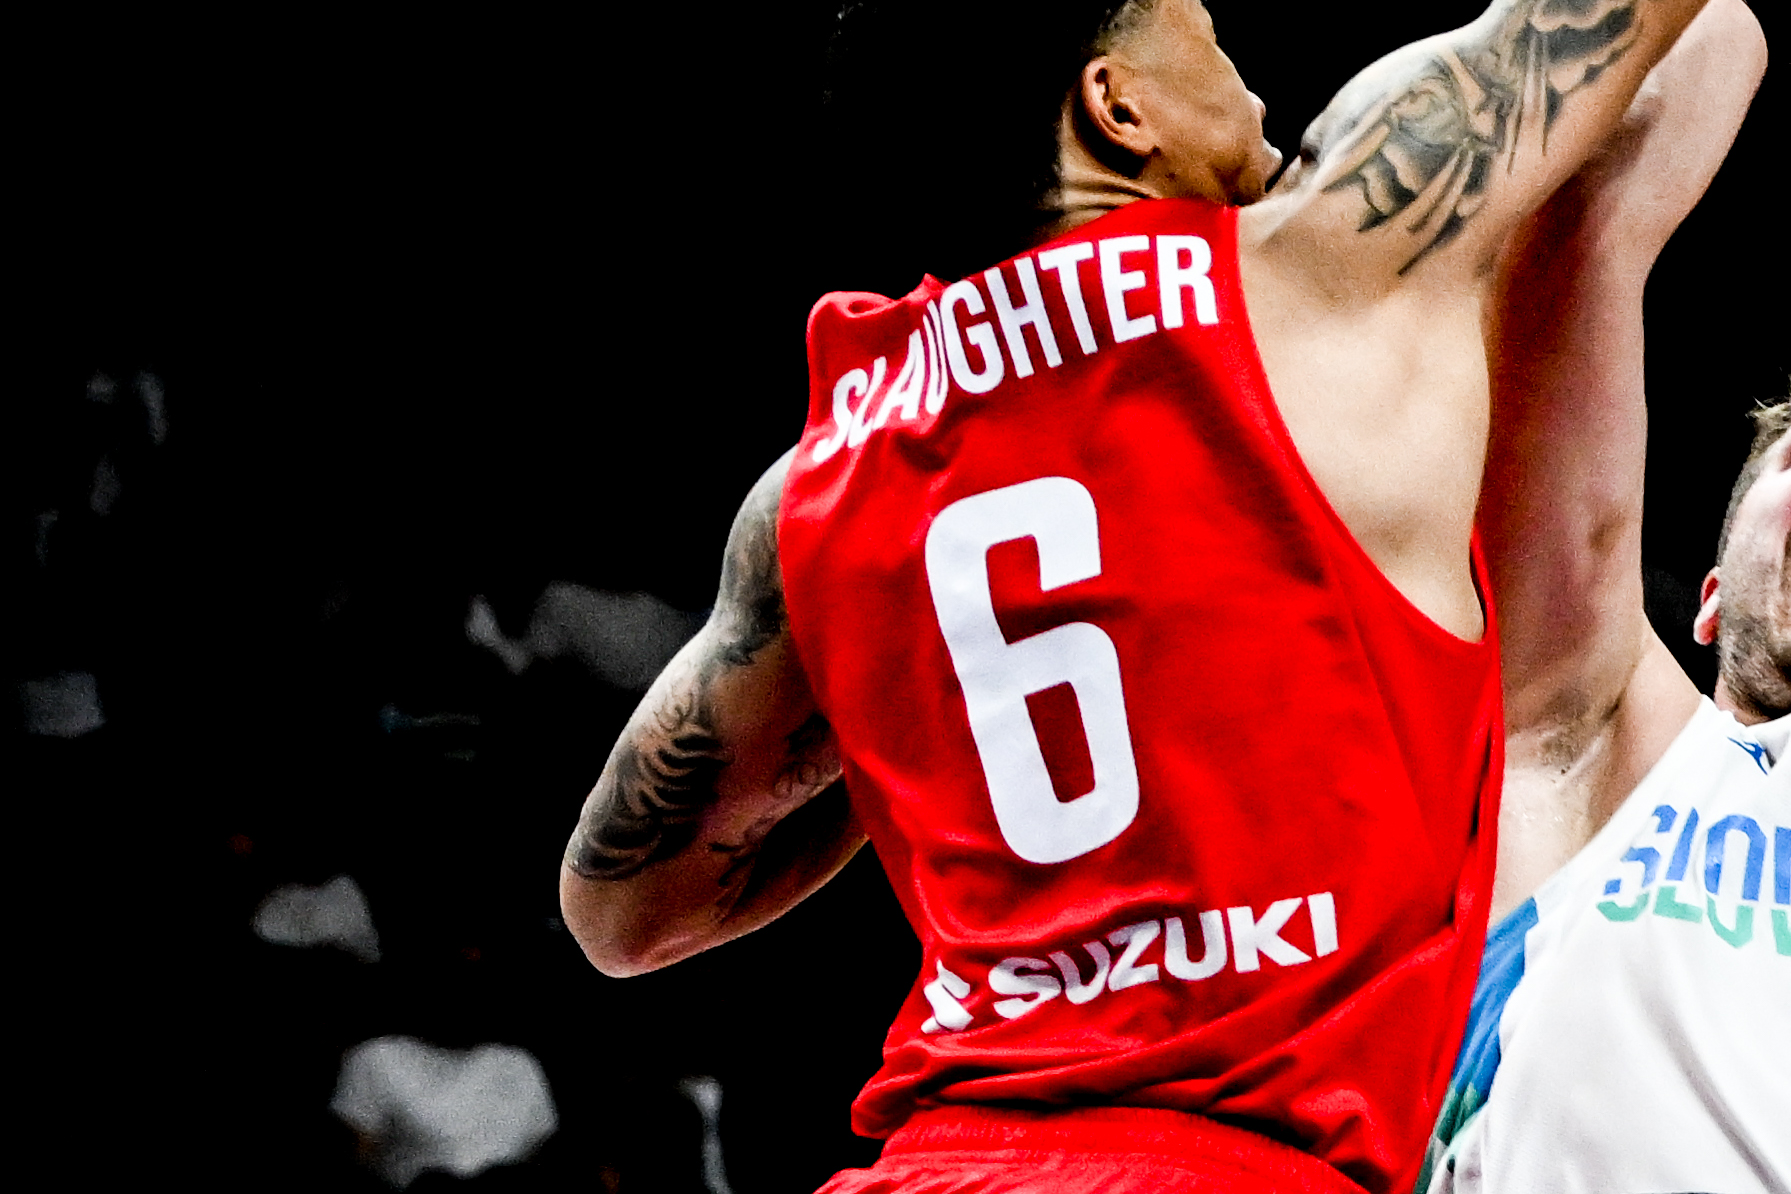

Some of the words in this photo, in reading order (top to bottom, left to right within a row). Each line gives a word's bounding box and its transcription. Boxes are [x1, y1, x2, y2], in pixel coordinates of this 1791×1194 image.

[812, 234, 1219, 463] SLAUGHTER
[924, 475, 1140, 864] 6
[988, 891, 1339, 1020] SUZUKI
